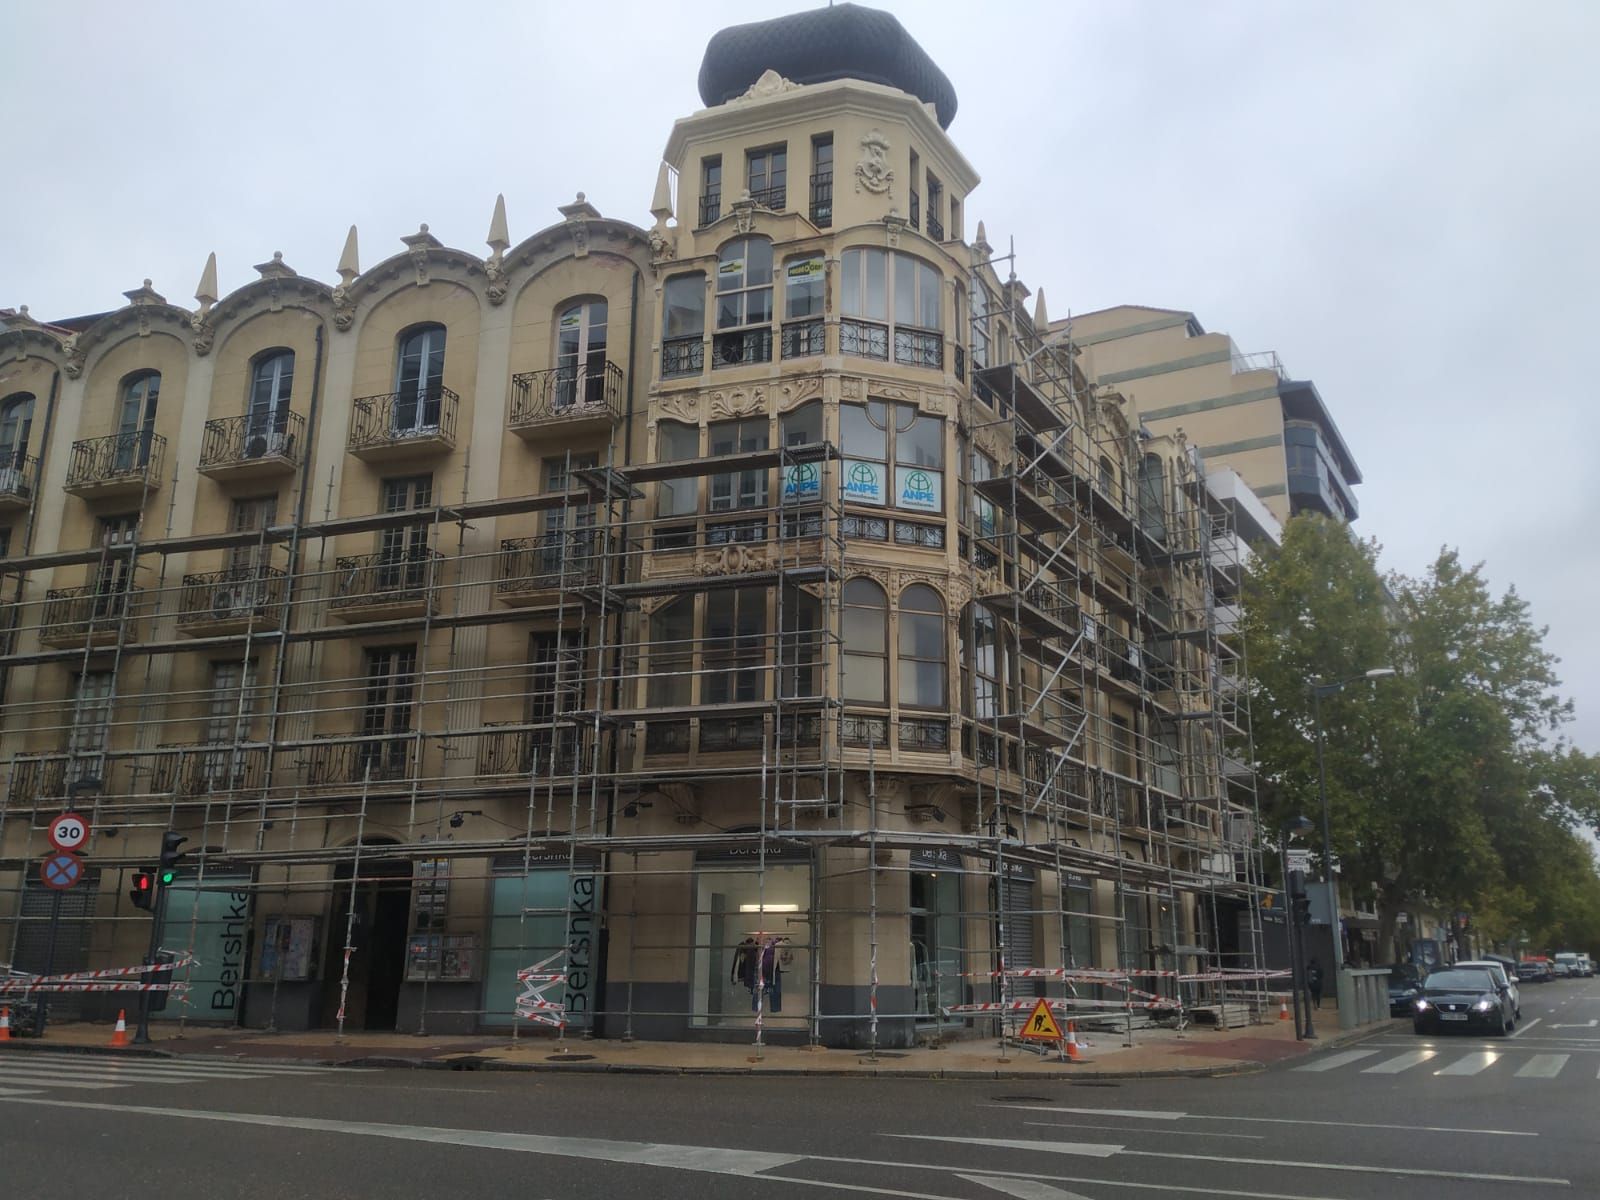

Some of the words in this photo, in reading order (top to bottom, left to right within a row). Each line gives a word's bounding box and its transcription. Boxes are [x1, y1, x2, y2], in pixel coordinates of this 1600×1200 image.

[785, 480, 818, 494] ANPE
[846, 481, 879, 495] ANPE
[902, 488, 935, 502] ANPE
[58, 826, 81, 839] 30
[211, 890, 249, 1010] Bershka
[560, 877, 593, 1013] Bershka
